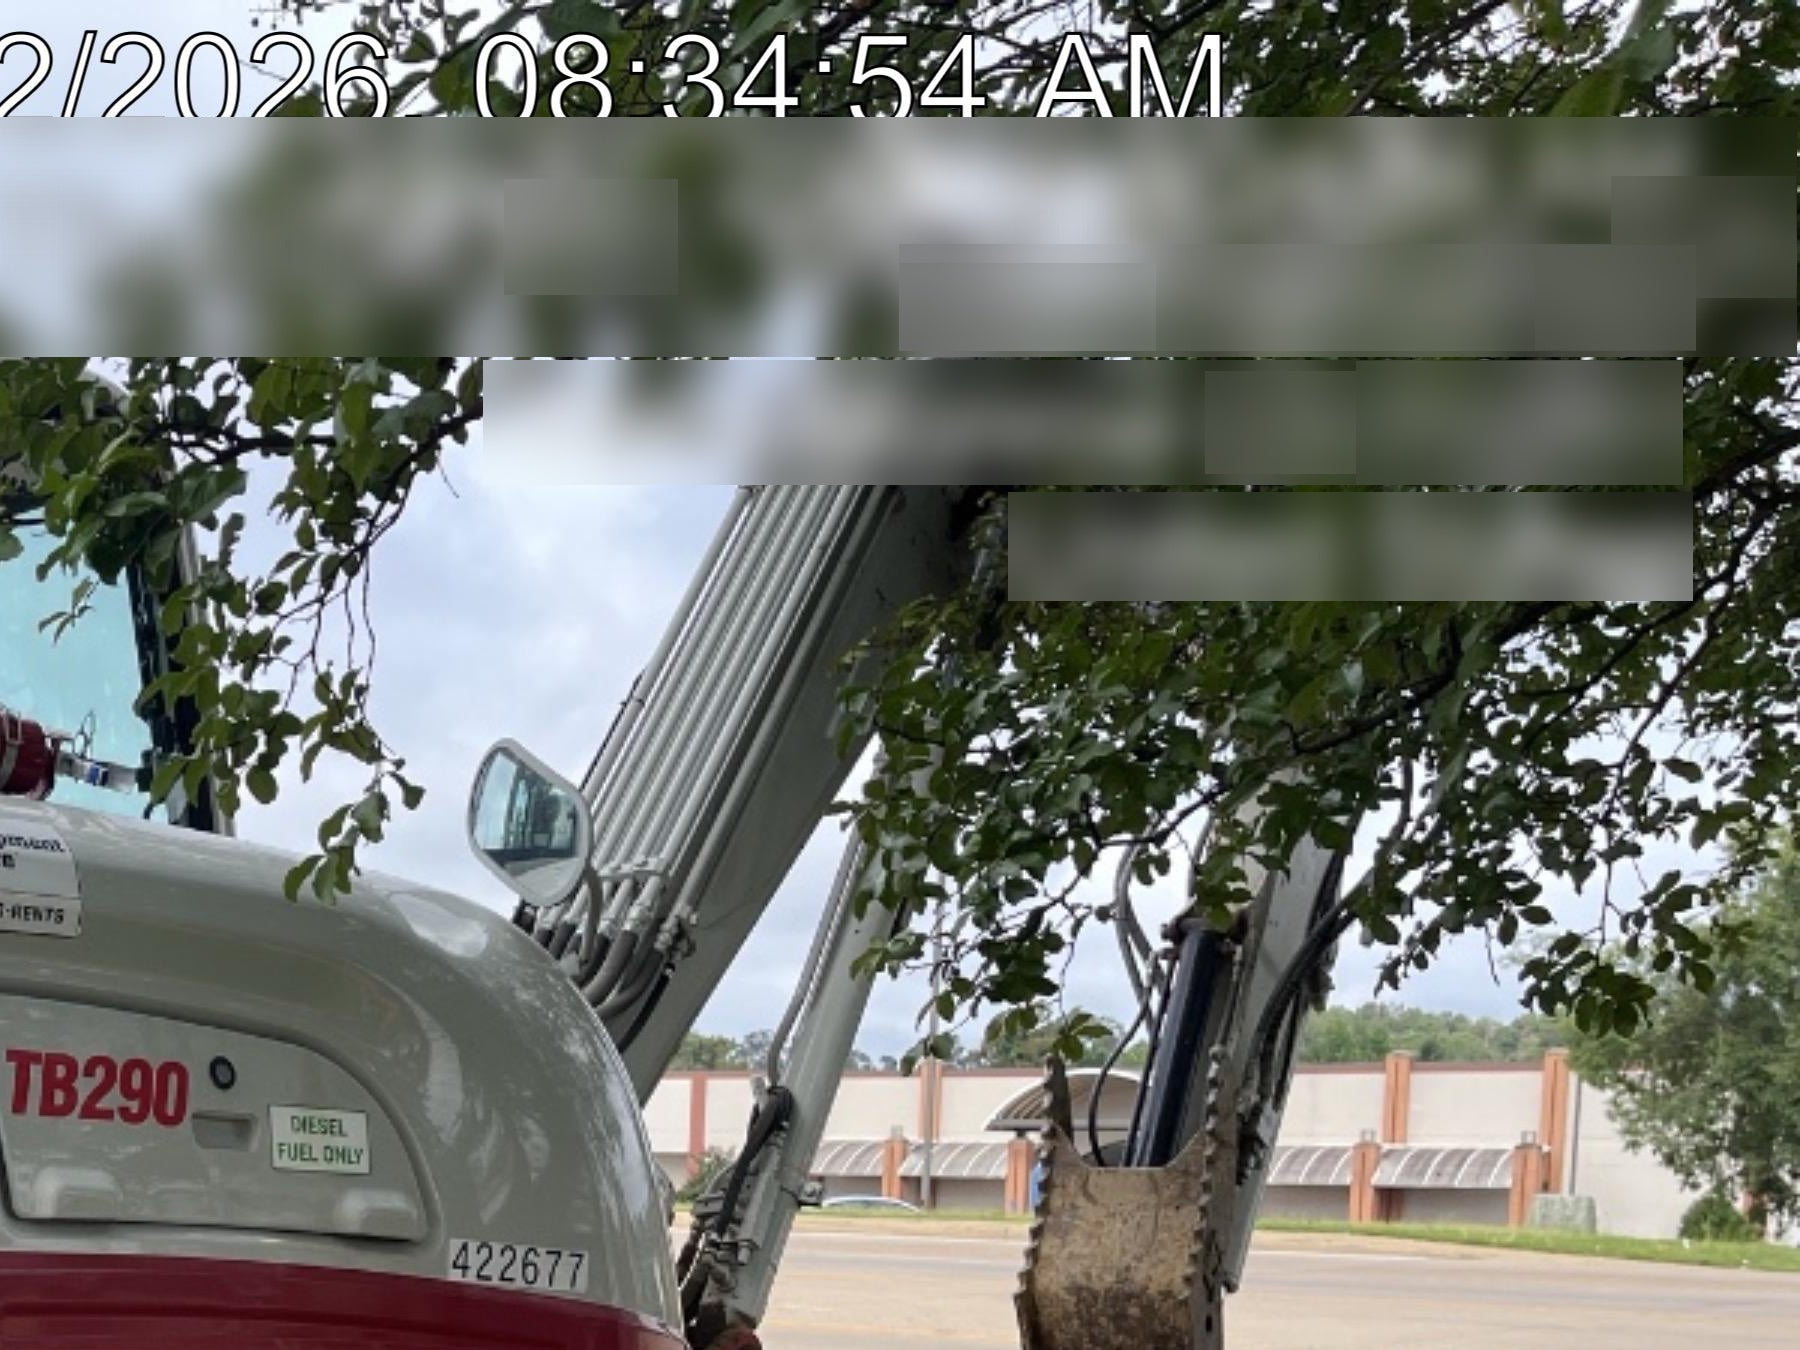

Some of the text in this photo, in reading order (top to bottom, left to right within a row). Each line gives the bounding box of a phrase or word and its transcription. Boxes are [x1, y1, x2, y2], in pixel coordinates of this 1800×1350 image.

[6, 1049, 190, 1128] TB290
[290, 1115, 348, 1137] DIESEL
[277, 1142, 364, 1165] FUEL ONLY
[452, 1241, 585, 1288] 422677
